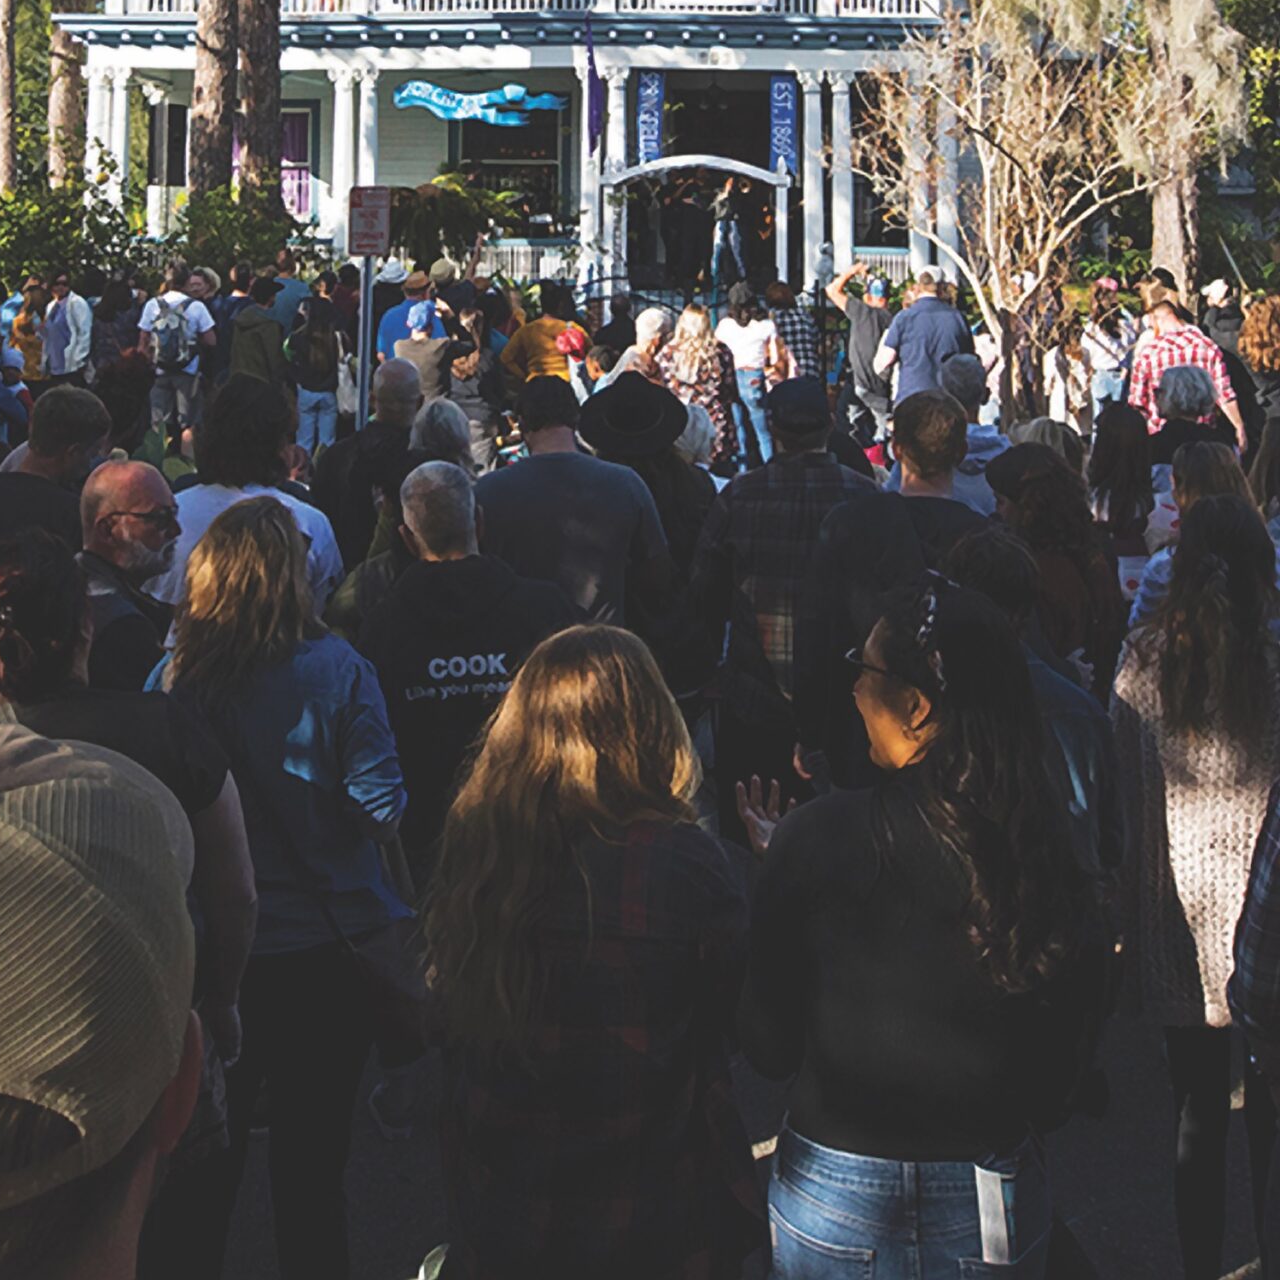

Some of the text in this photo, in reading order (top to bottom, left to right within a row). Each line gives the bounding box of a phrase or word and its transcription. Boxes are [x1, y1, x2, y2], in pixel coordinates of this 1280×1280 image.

[772, 82, 793, 155] EST. 1869
[428, 652, 509, 680] COOK
[440, 684, 469, 701] you
